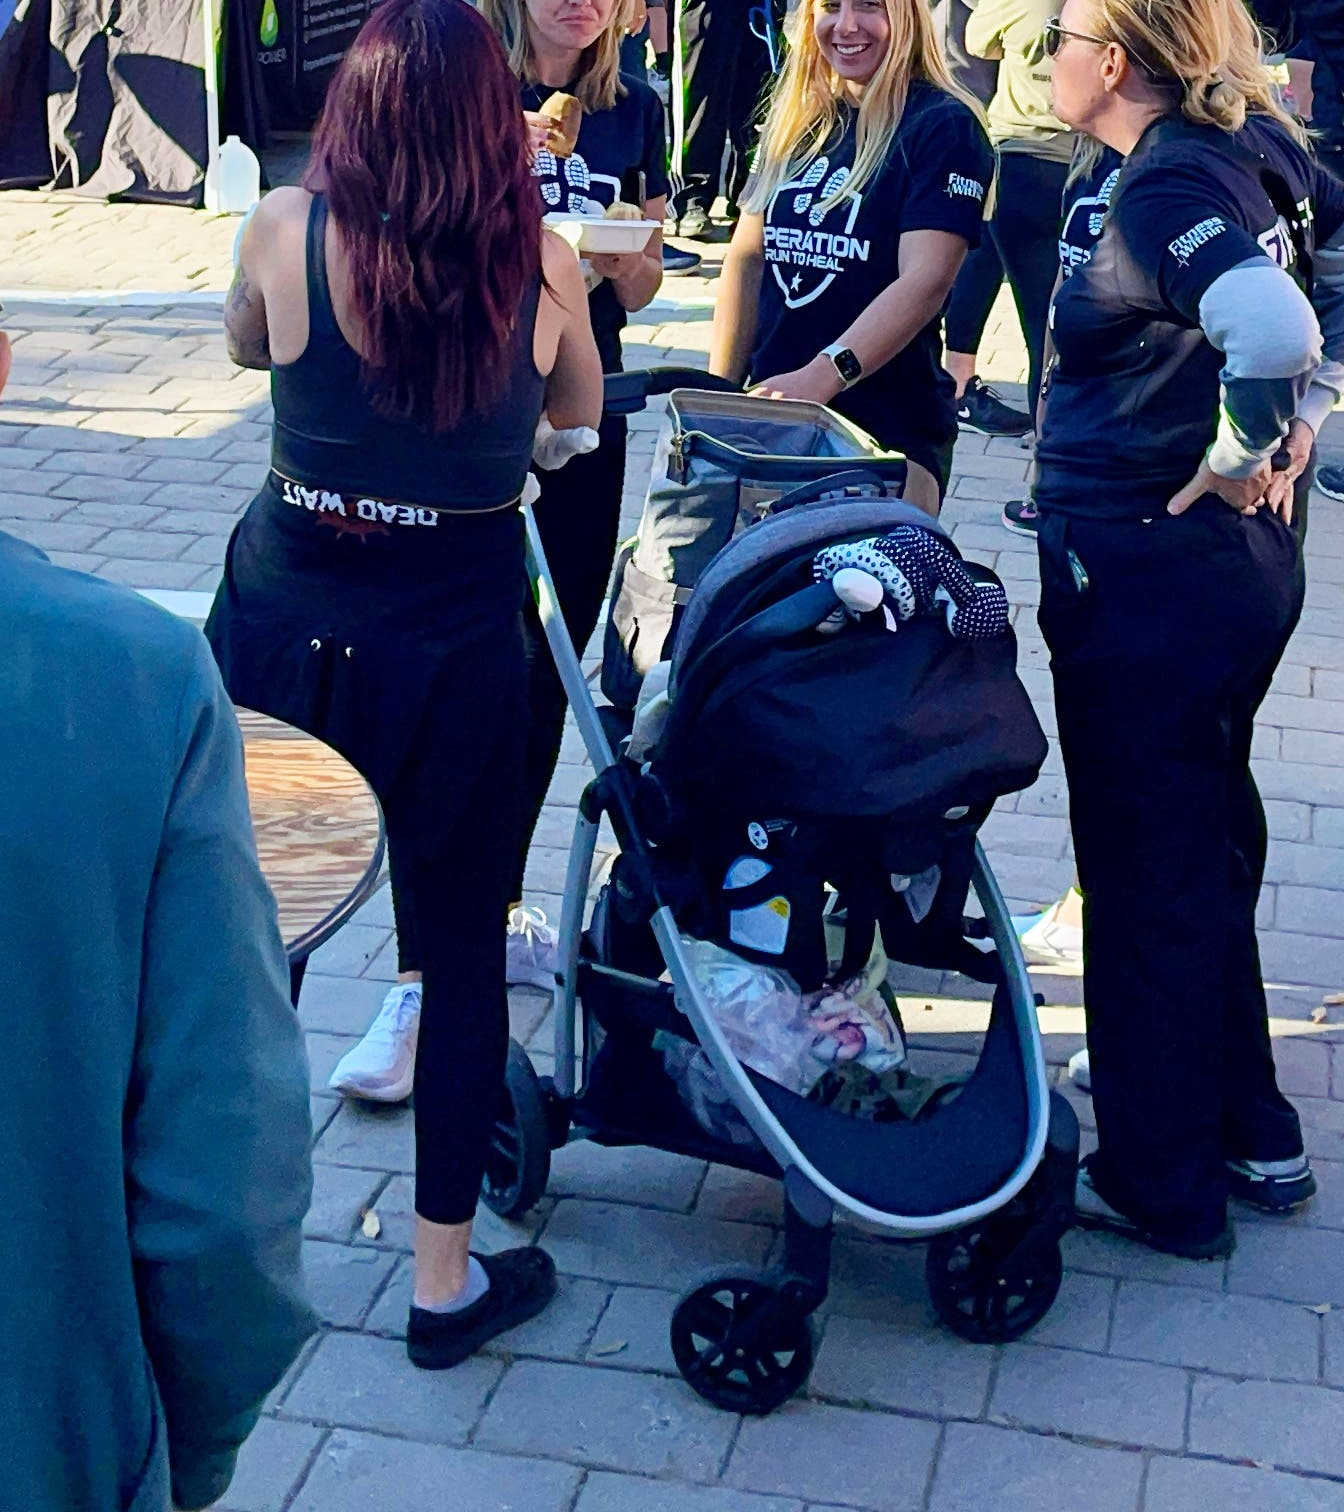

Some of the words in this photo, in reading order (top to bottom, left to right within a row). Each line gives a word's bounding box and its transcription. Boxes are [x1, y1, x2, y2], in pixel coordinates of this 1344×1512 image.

[763, 226, 871, 262] PERATION
[1168, 216, 1227, 257] Fitness
[1178, 225, 1227, 259] Within
[765, 248, 790, 264] RUN
[791, 251, 806, 266] TO
[806, 254, 845, 272] HEAL
[282, 481, 348, 518] WAIT
[357, 498, 439, 527] DEAD
